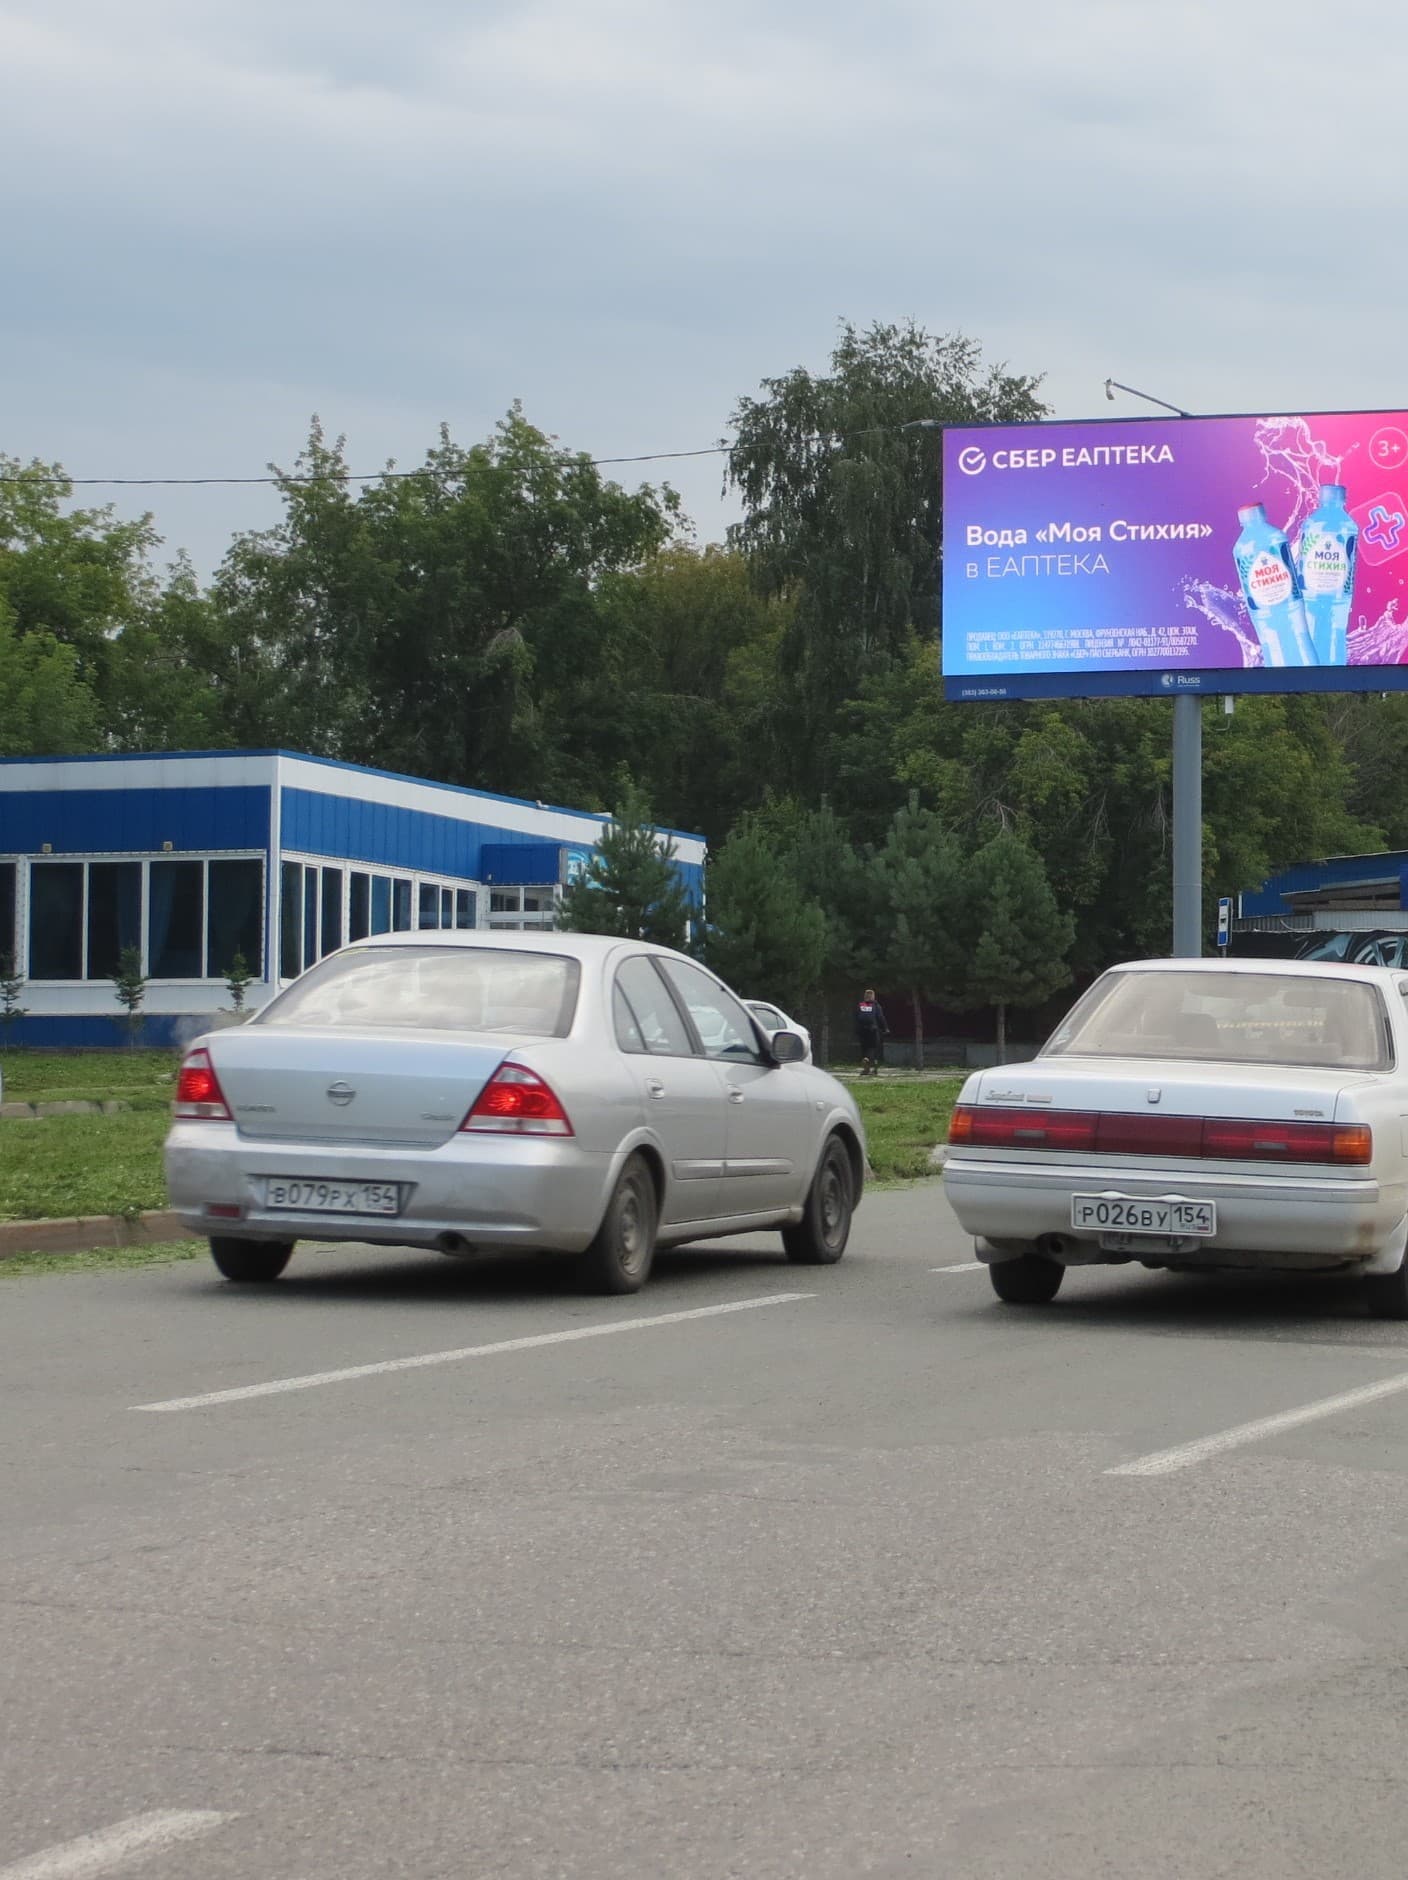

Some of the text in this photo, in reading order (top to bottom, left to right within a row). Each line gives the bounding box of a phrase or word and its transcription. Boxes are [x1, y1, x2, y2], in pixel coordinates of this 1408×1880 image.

[992, 444, 1175, 470] СБЕР ЕАПТЕКА
[1378, 440, 1401, 457] 3+
[966, 519, 1213, 549] Вода «Моя Стихия»
[1314, 551, 1340, 561] МОЯ
[966, 553, 1112, 578] в ЕАПТЕКА
[1254, 563, 1280, 578] МОЯ
[1306, 561, 1347, 571] СТИХИЯ
[1250, 571, 1289, 589] СТИХИЯ
[1177, 675, 1200, 684] Russ
[274, 1183, 395, 1208] В079РХ 154
[1082, 1203, 1206, 1227] Р026ВУ 154
